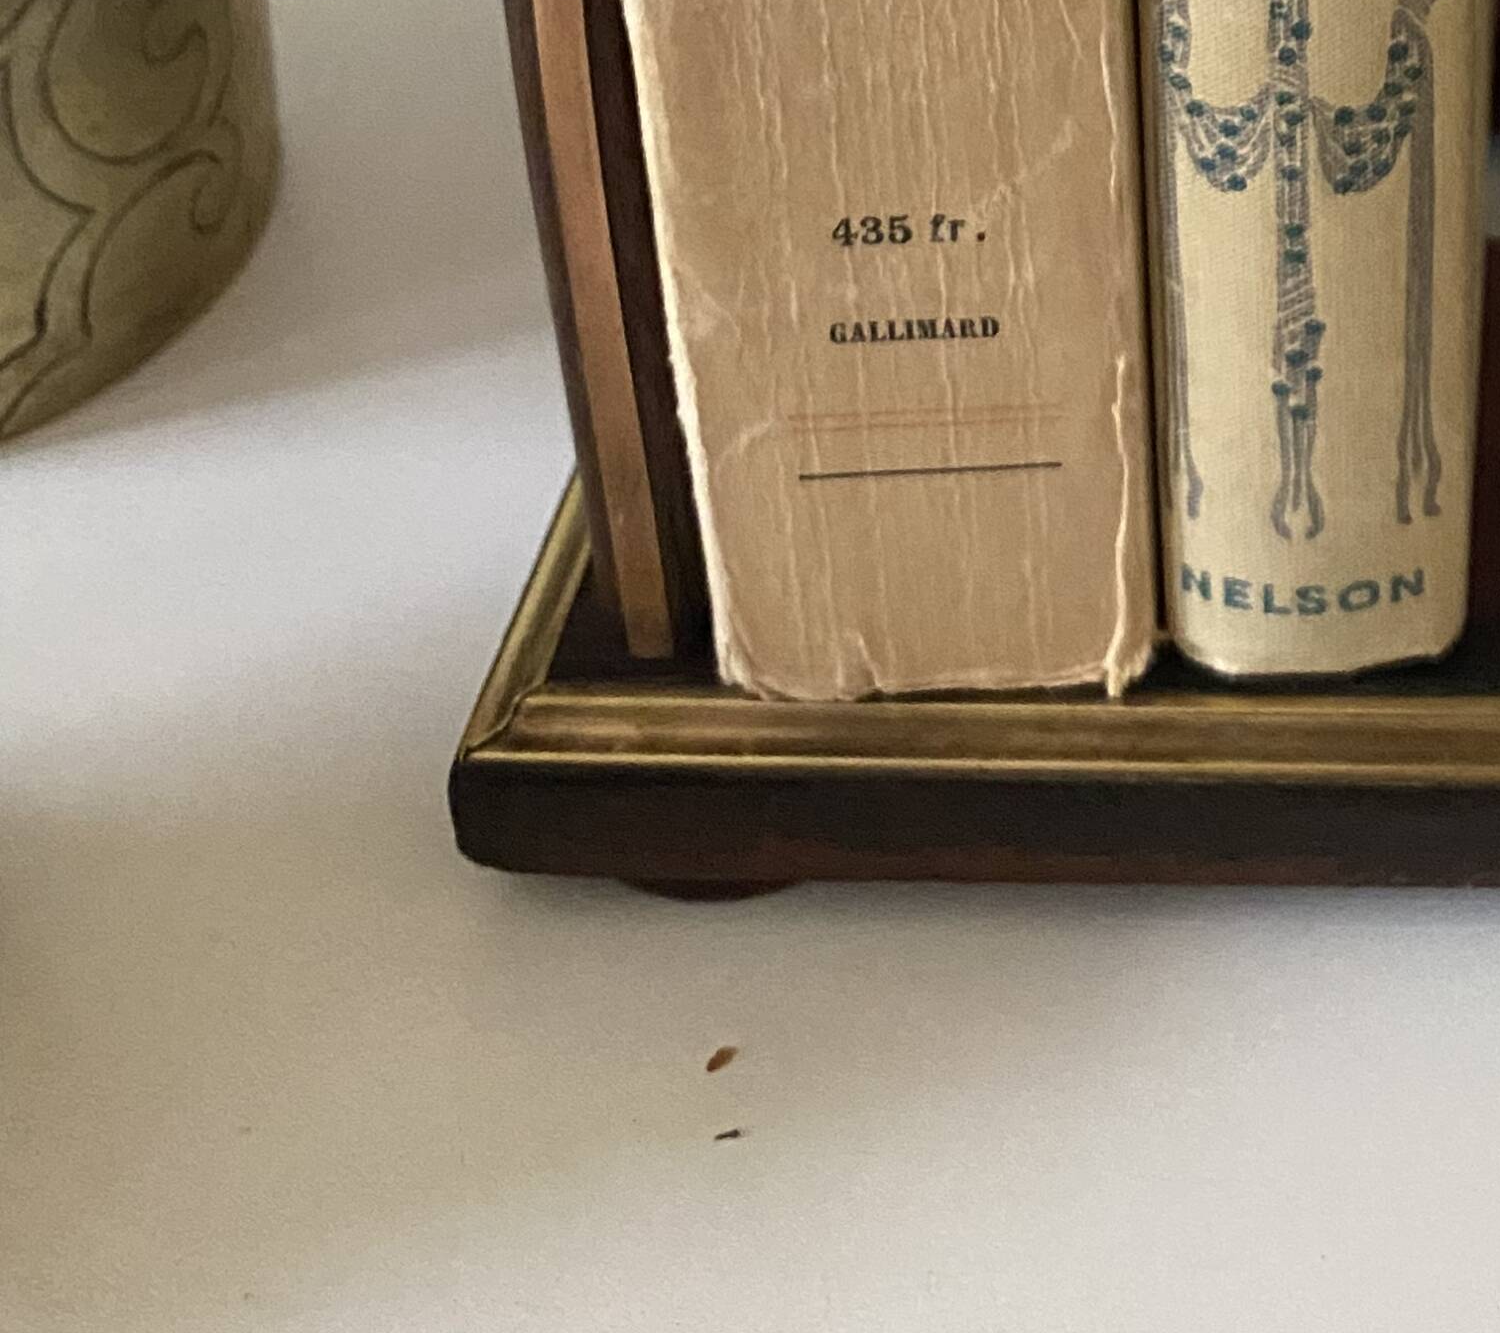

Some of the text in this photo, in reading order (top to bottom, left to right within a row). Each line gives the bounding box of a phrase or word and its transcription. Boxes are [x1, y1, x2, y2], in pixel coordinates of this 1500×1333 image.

[832, 213, 986, 247] 435 fr.
[829, 315, 1000, 345] GALLIMARD
[1180, 561, 1425, 617] NELSON
